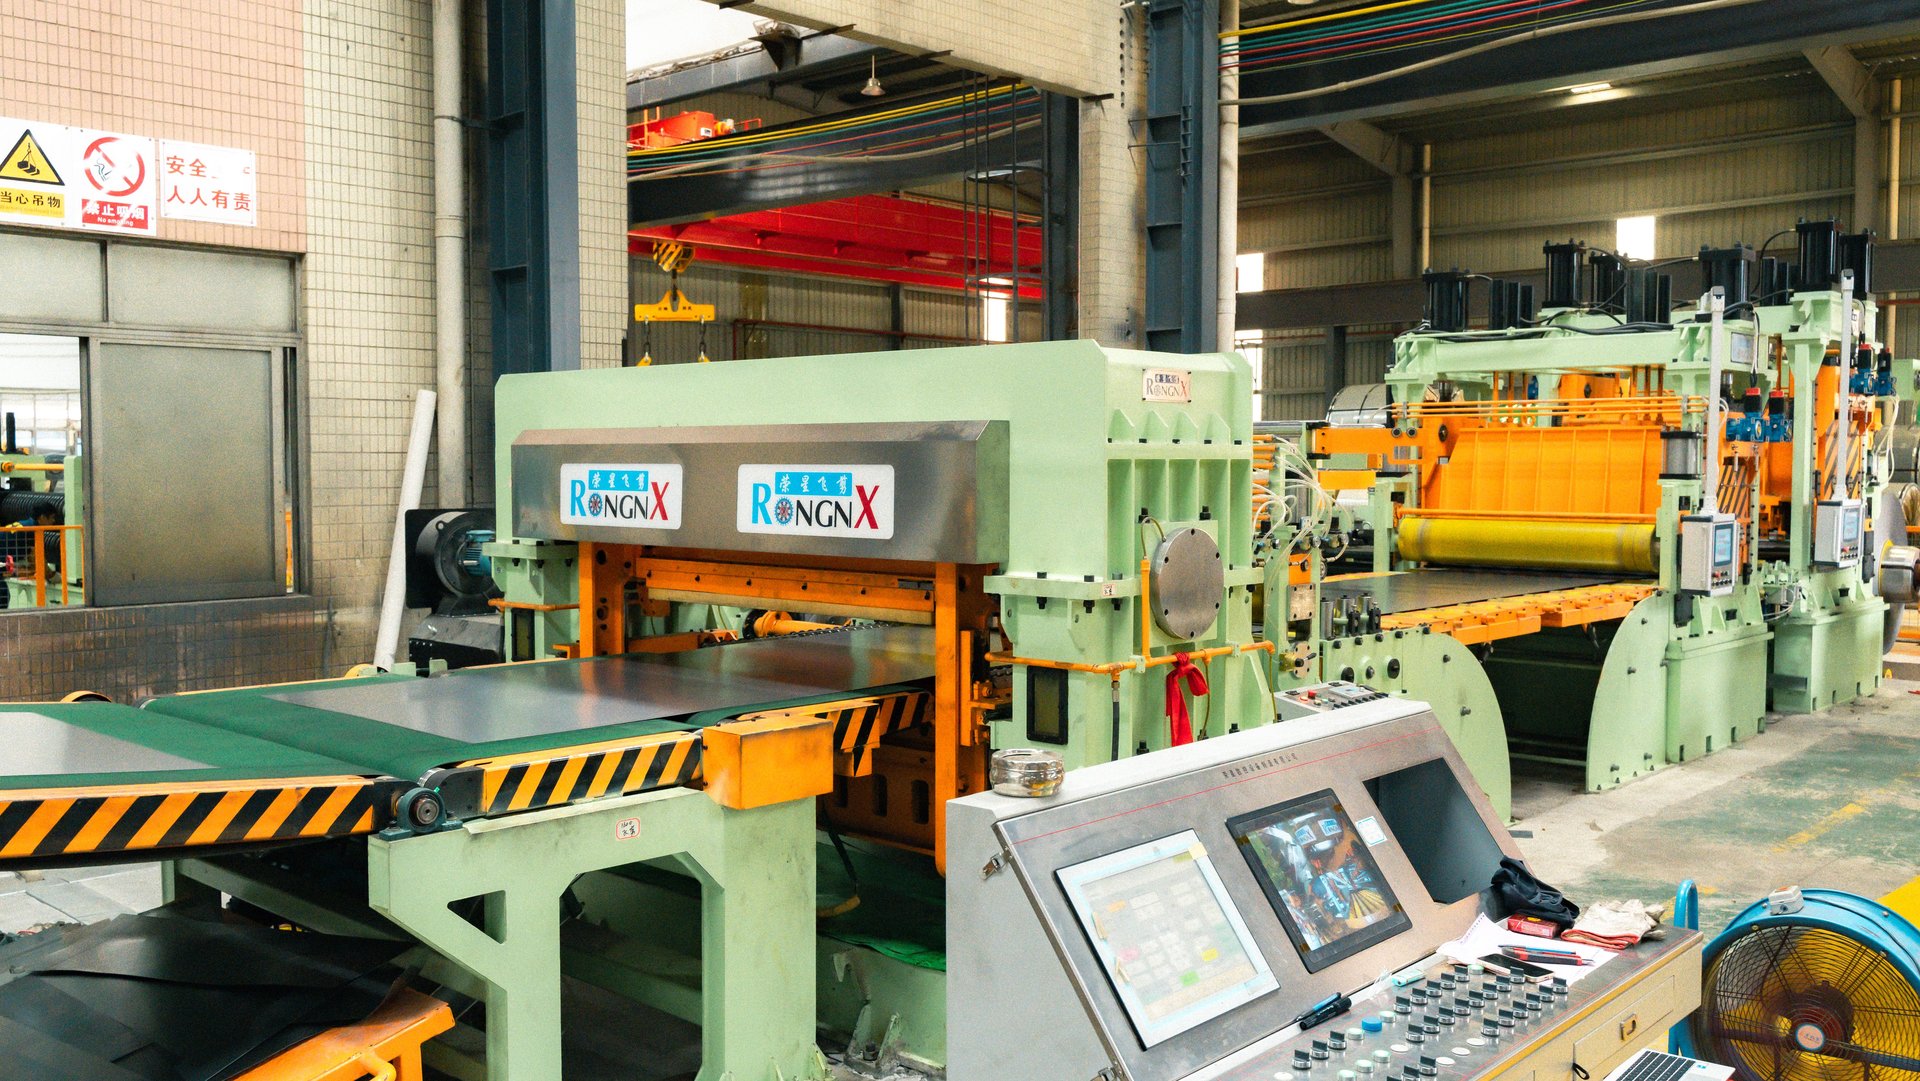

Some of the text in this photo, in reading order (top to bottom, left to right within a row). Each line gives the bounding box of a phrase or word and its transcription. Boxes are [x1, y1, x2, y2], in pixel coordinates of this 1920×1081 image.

[0, 191, 61, 208] 当心吊物
[167, 185, 251, 212] 人人有责
[779, 473, 848, 495] 荣星飞剪
